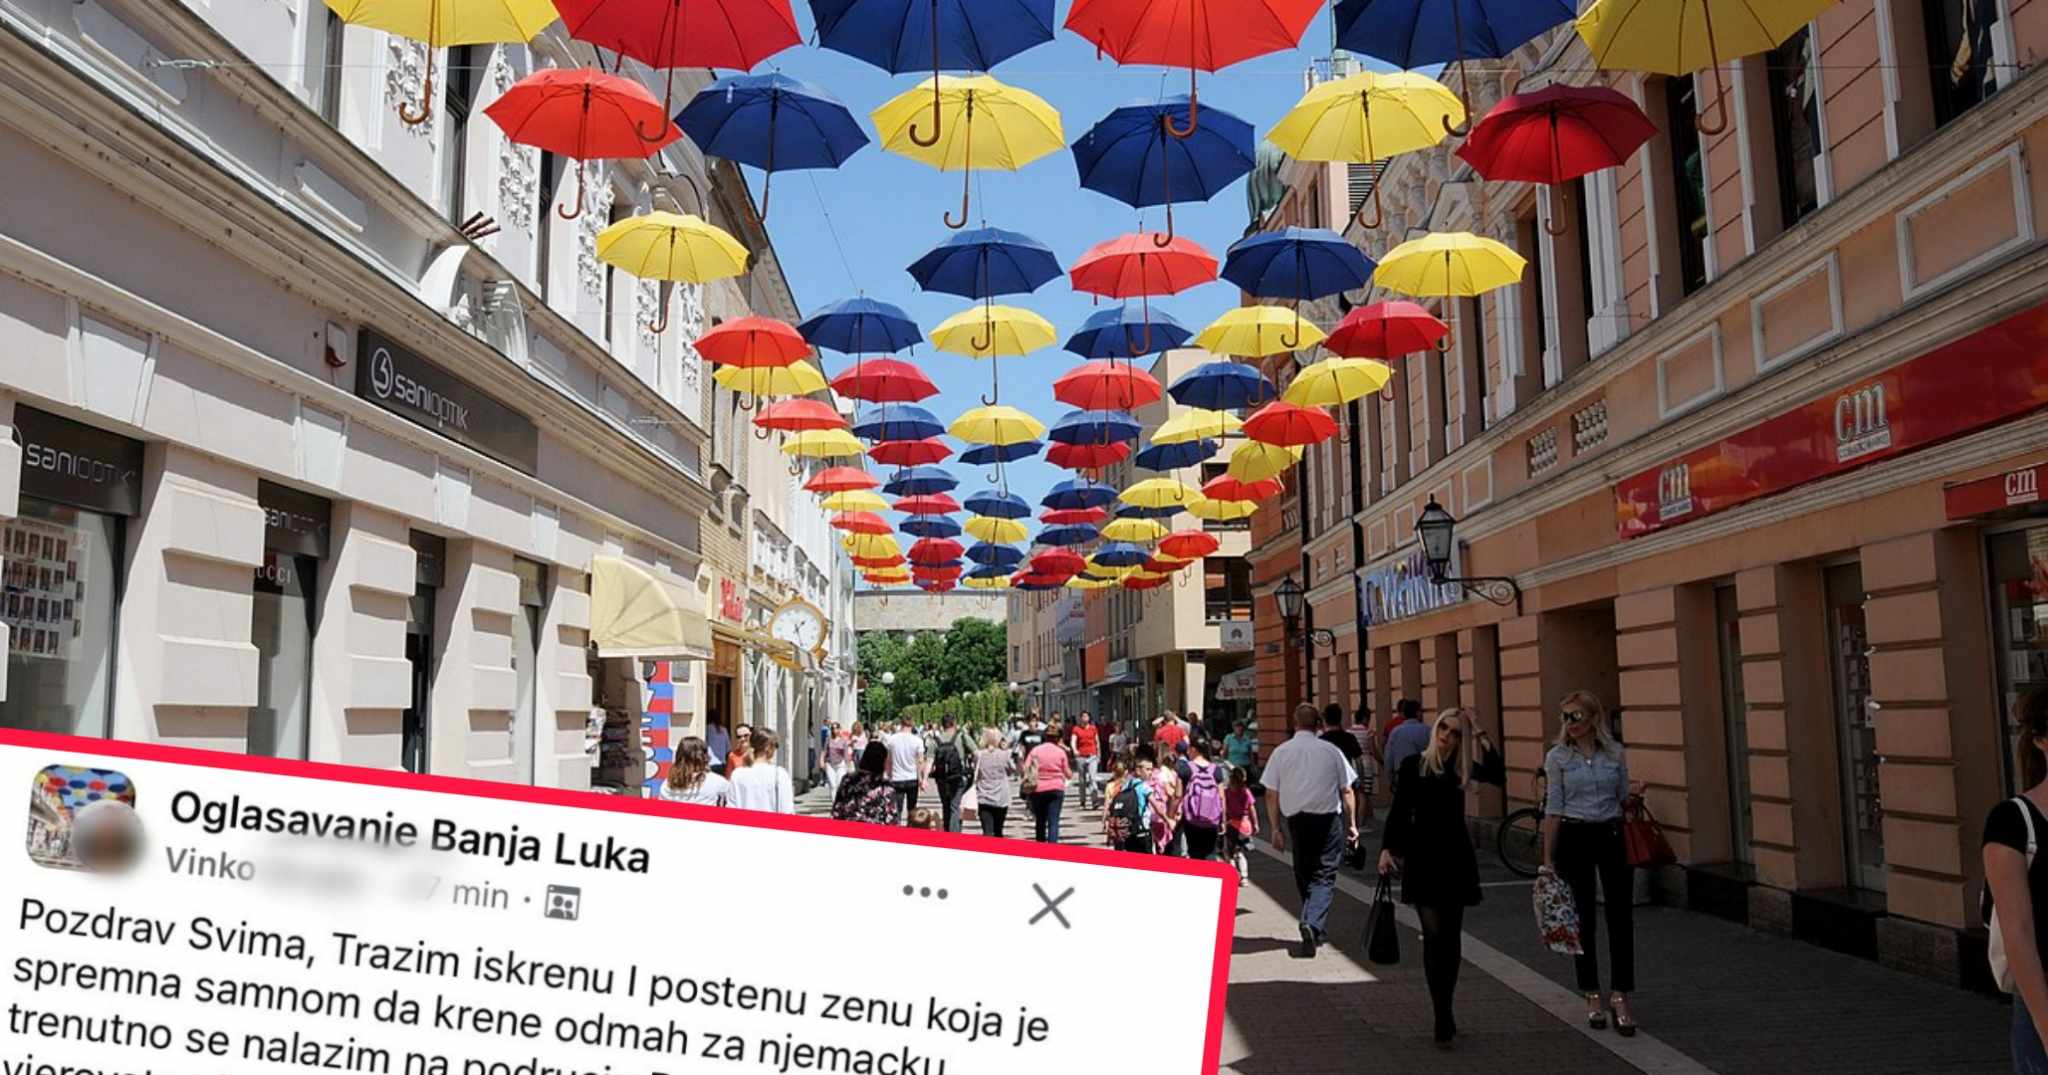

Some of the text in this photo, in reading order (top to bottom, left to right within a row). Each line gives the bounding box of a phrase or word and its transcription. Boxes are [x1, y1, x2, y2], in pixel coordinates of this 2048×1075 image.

[1835, 384, 1888, 440] cm
[1658, 463, 1688, 503] cm
[2004, 469, 2038, 496] cm
